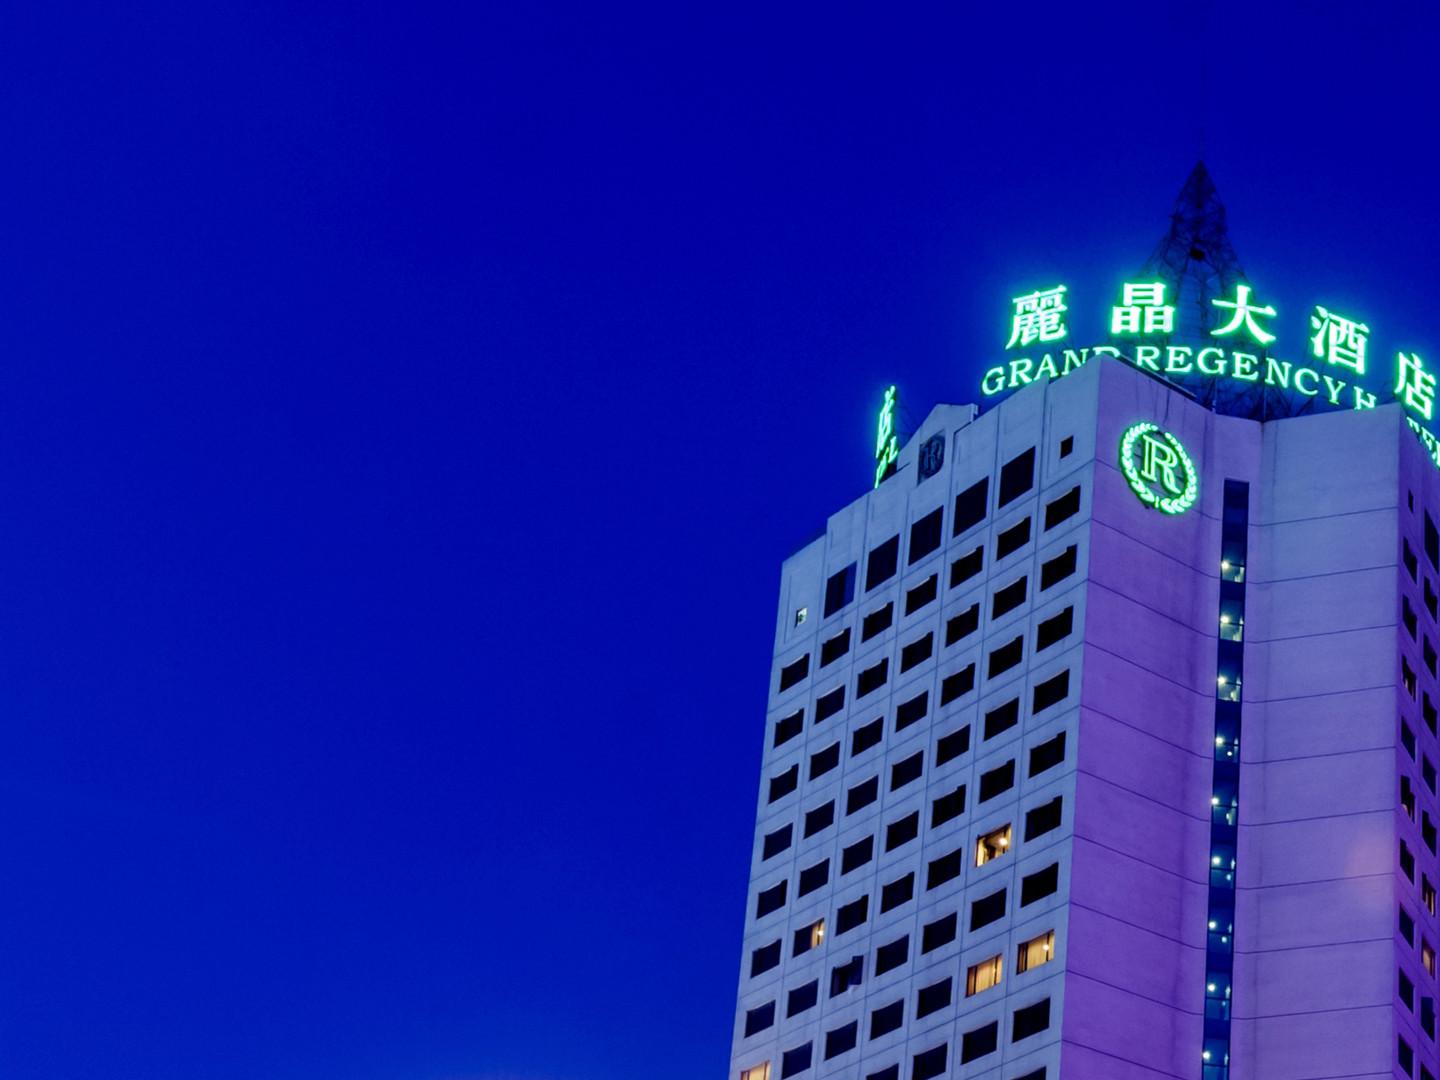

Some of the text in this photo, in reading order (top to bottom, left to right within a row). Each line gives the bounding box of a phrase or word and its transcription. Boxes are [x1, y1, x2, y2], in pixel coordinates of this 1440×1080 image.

[1006, 283, 1437, 420] 麗晶大酒店
[1134, 345, 1345, 406] REGENCY
